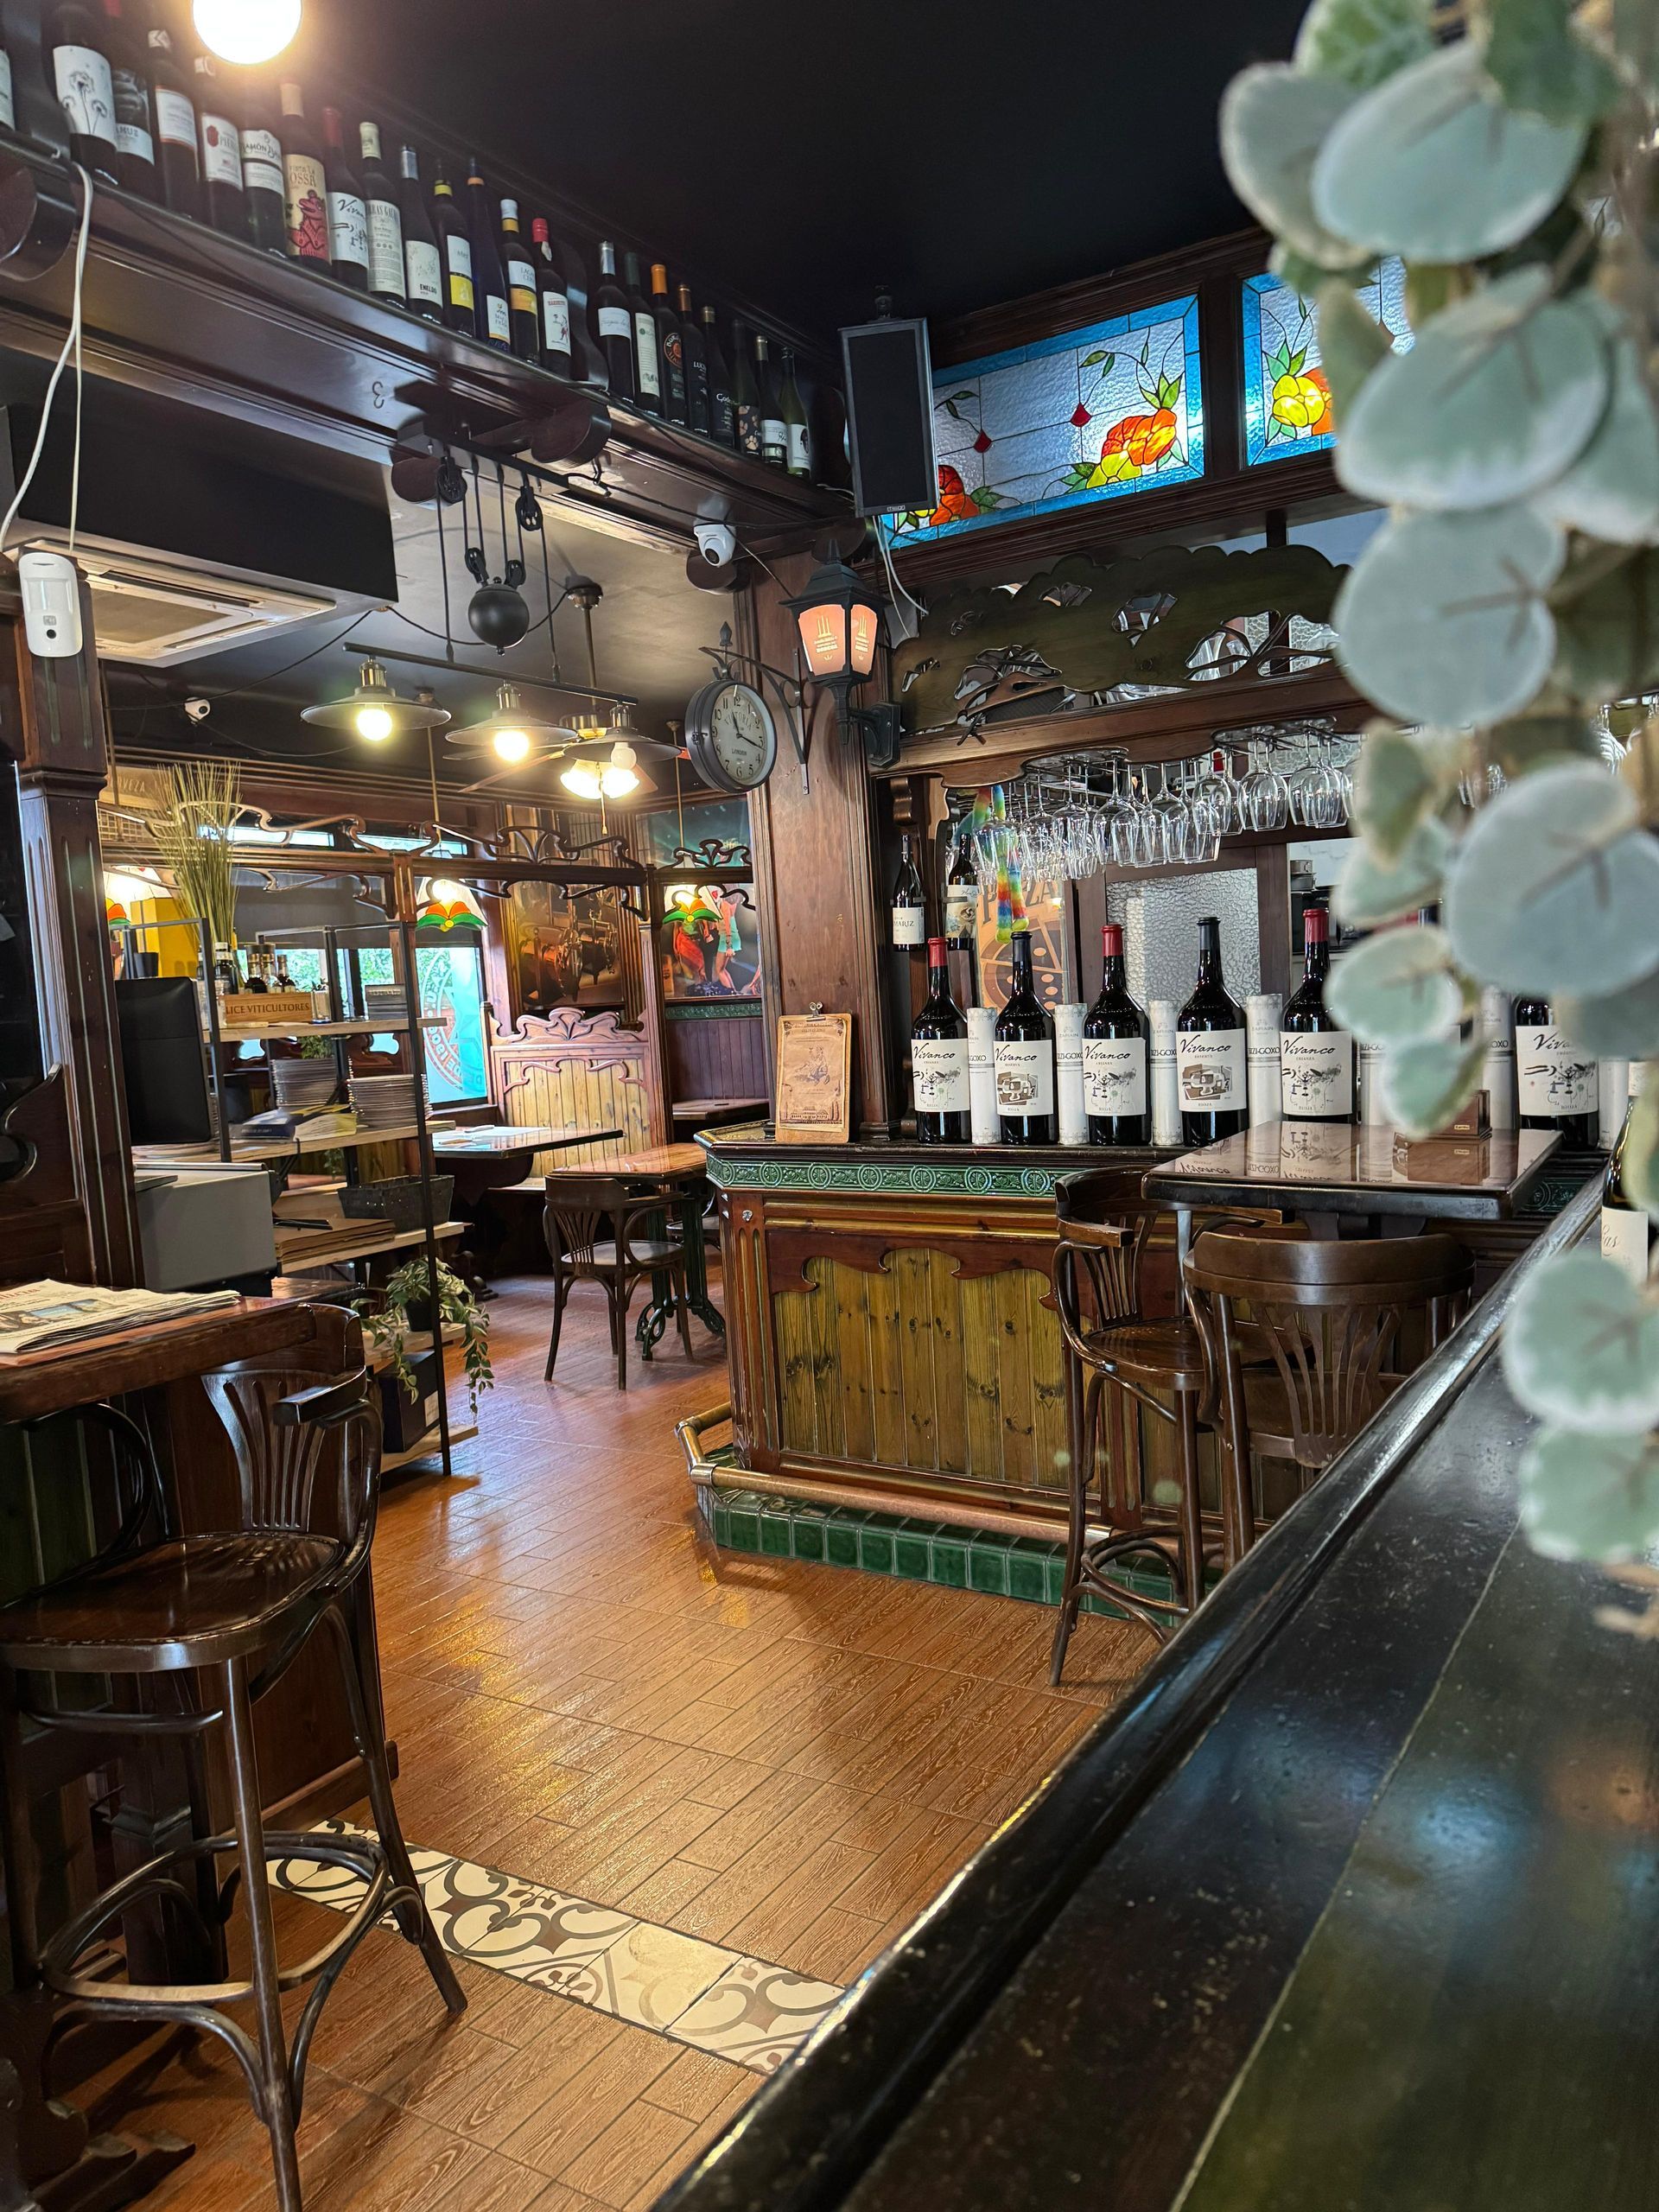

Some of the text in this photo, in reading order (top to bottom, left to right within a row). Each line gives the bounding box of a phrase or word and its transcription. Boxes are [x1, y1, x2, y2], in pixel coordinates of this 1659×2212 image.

[913, 1042, 956, 1059] Vivanco
[1084, 1041, 1131, 1059] Vivanco
[1179, 1033, 1232, 1053] Vivanco
[1283, 1035, 1336, 1055] Vivanco
[1533, 1032, 1570, 1051] Viva
[995, 1044, 1038, 1061] Vivanco
